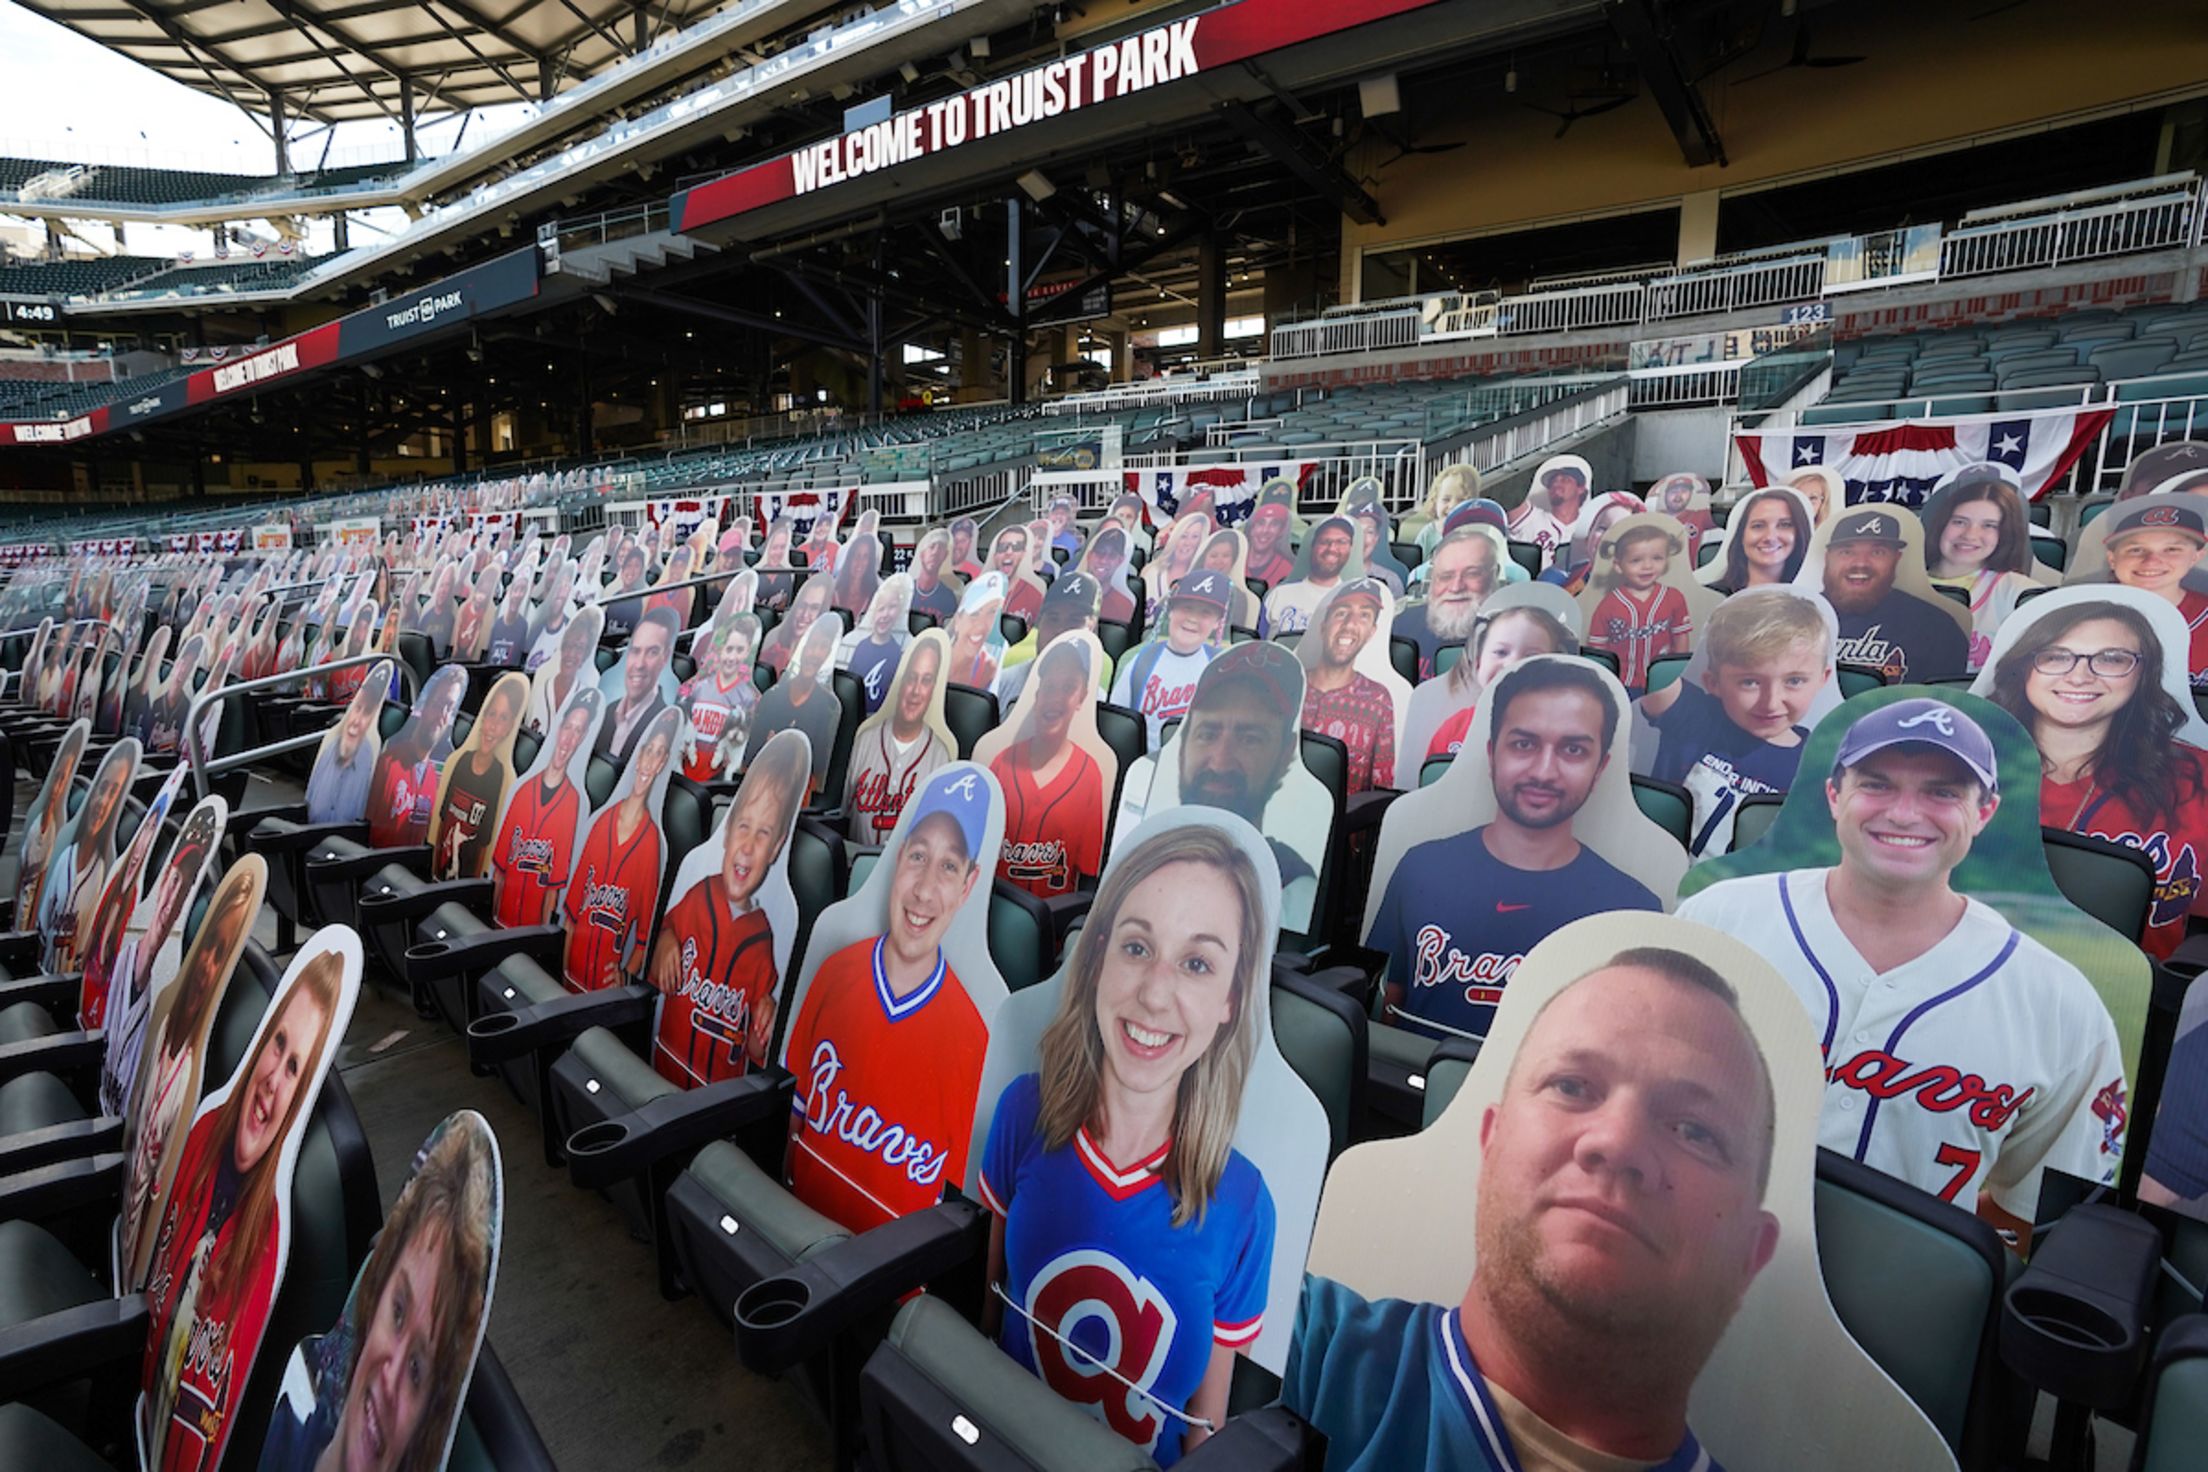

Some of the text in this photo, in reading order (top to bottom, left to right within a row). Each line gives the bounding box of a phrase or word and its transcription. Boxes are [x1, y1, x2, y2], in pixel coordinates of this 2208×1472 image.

[791, 16, 1200, 195] WELCOME TO TRUIST PARK
[16, 305, 54, 321] 4:49
[386, 290, 462, 329] TRUIST PARK
[1789, 304, 1825, 322] 123
[806, 1039, 949, 1185] Braves
